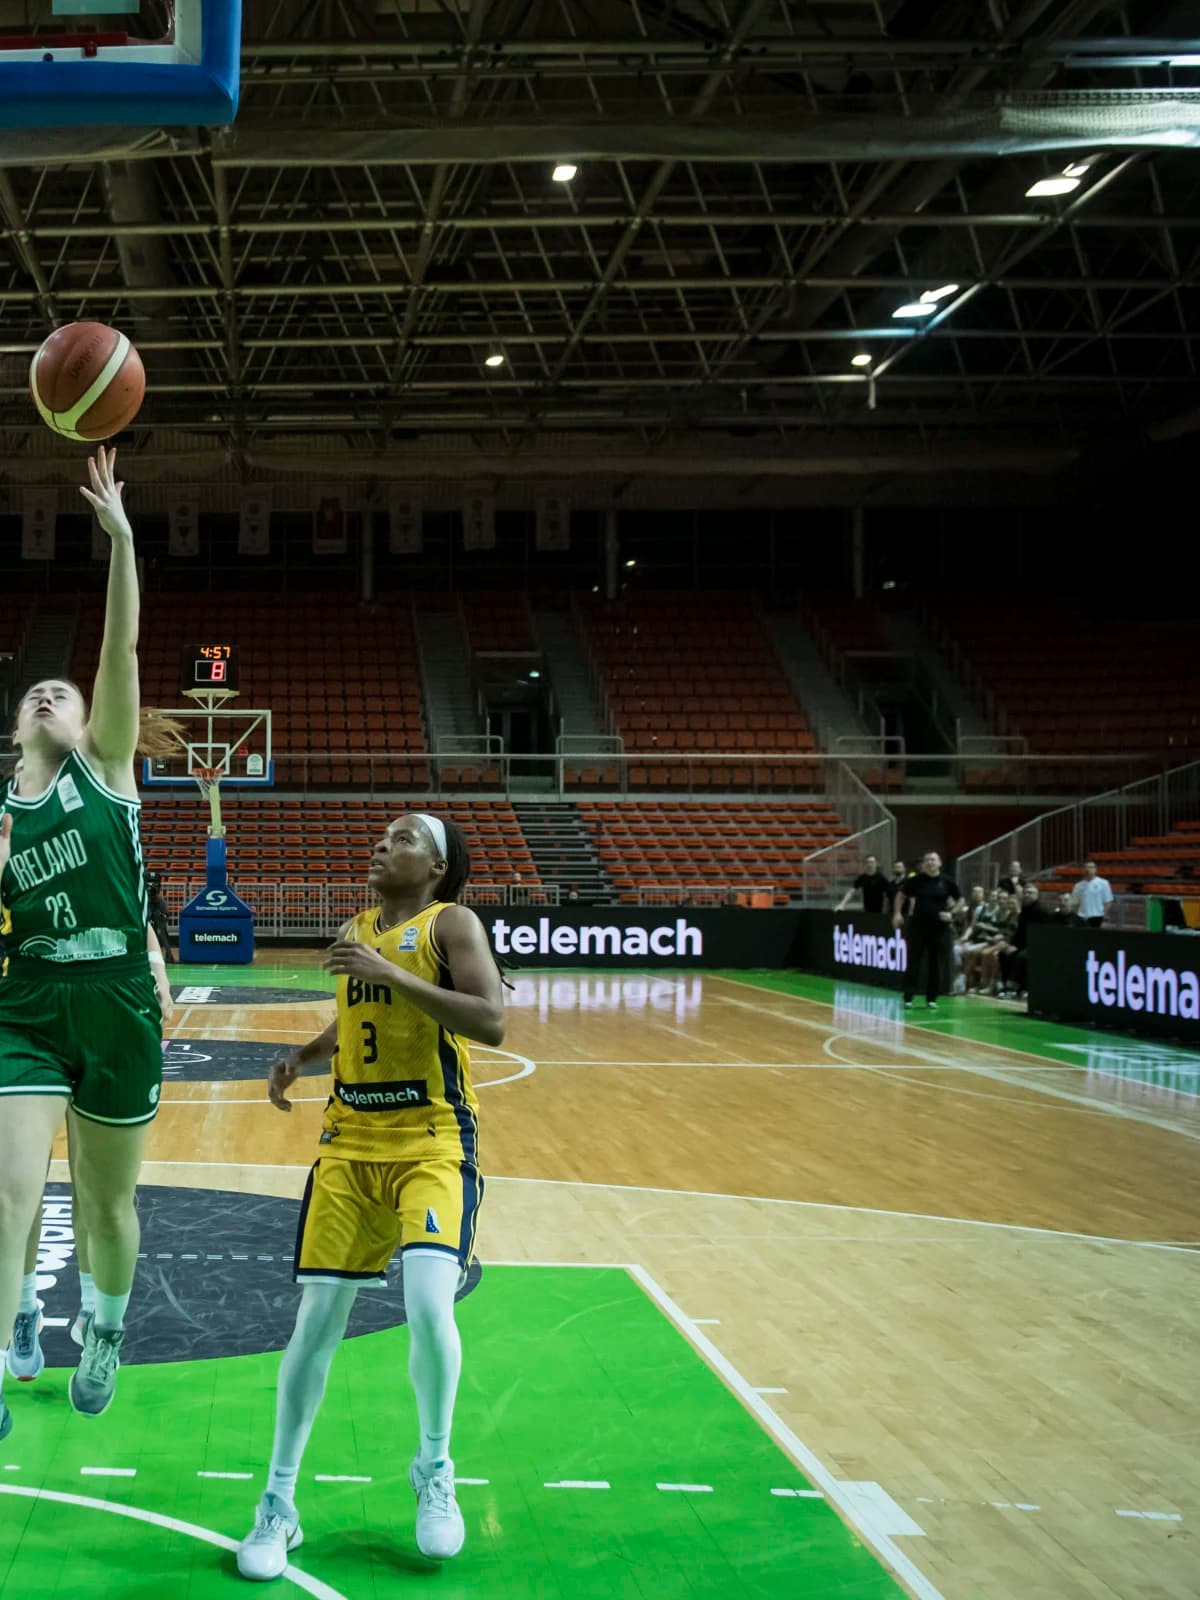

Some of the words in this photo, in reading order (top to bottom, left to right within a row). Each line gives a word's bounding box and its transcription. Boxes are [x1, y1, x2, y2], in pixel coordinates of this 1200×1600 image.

[200, 647, 231, 659] 4:57
[211, 661, 225, 680] 8
[9, 829, 88, 891] IRELAND
[45, 892, 77, 929] 23
[194, 933, 238, 942] telemach
[492, 917, 703, 956] telemach
[833, 924, 908, 972] telemach
[361, 1021, 378, 1064] 3
